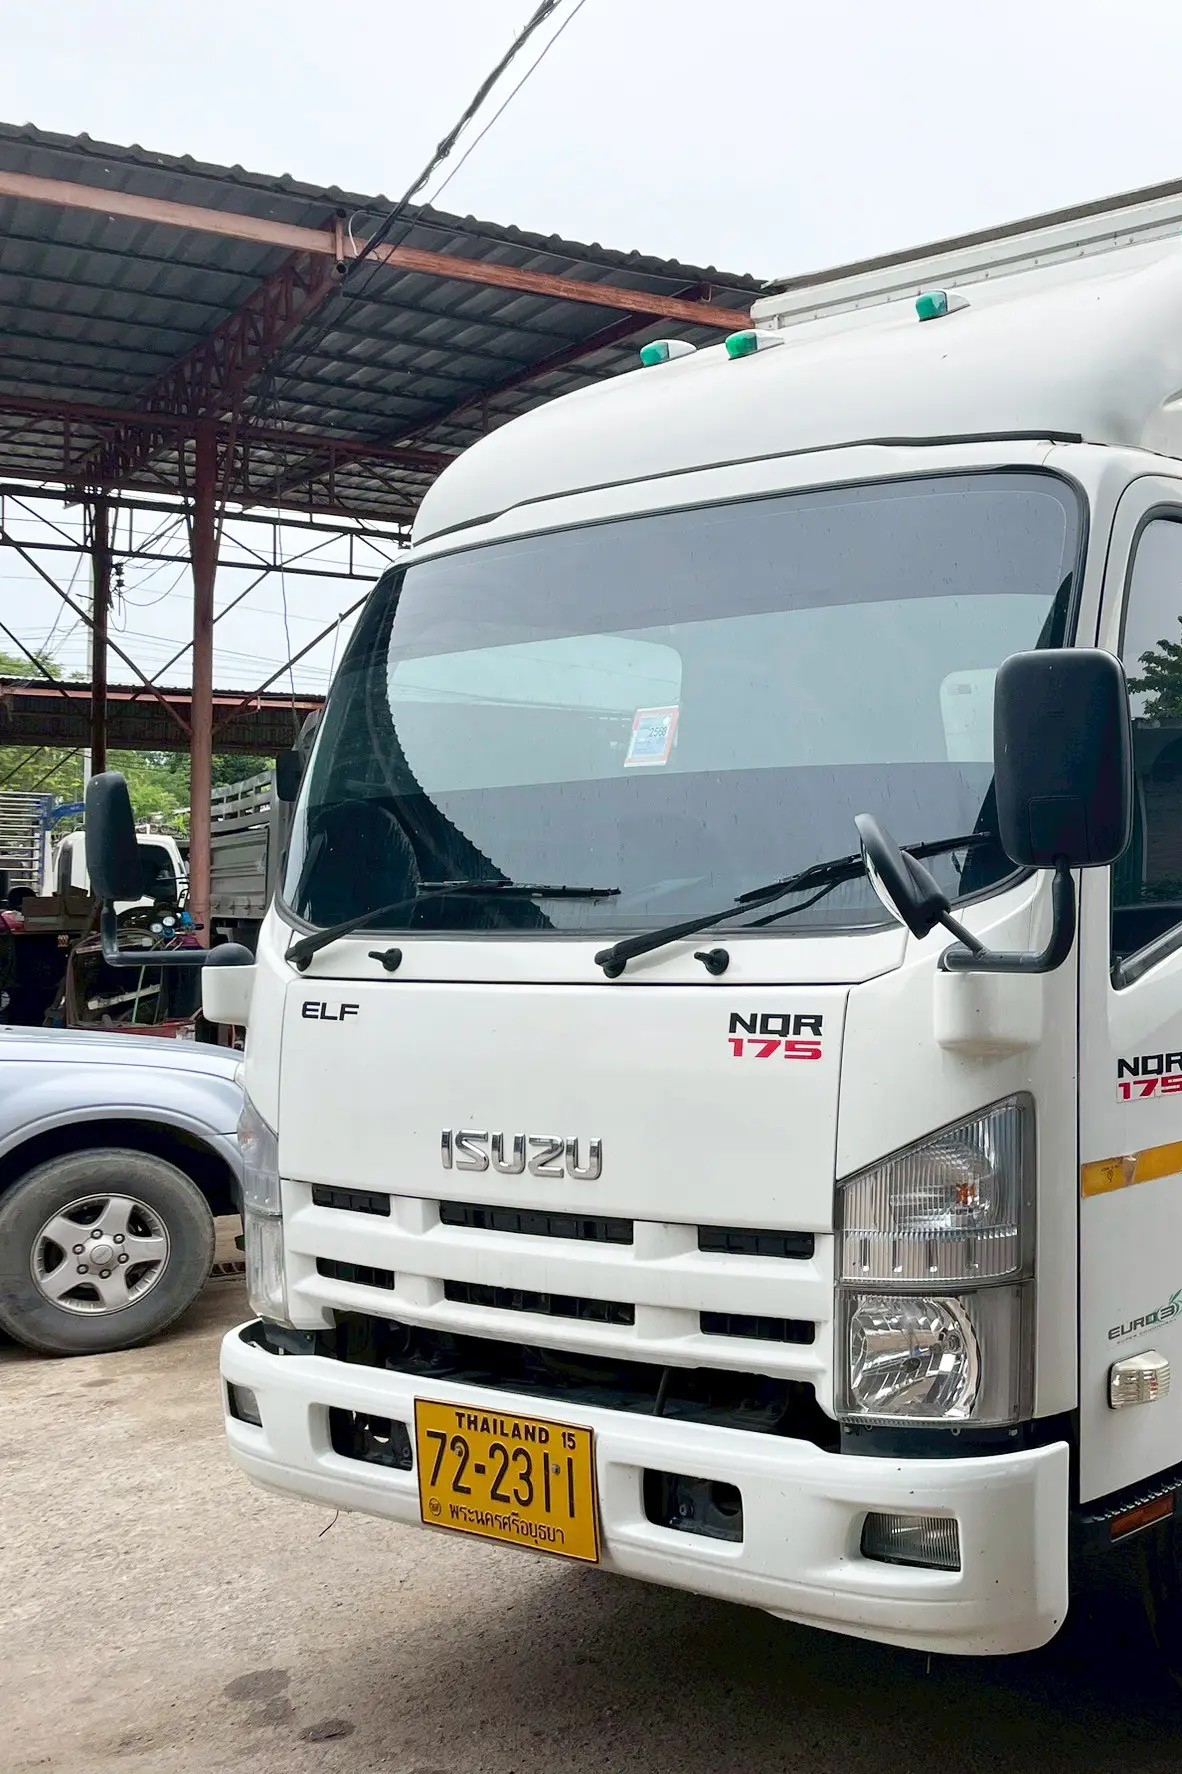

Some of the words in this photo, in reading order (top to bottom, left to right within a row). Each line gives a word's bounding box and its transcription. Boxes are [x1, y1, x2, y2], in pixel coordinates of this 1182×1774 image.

[302, 1001, 360, 1021] ELF
[728, 1012, 823, 1038] NQR
[728, 1038, 822, 1060] 175
[441, 1128, 602, 1180] ISUZU
[455, 1411, 550, 1444] THAILAND
[561, 1432, 576, 1450] 15
[426, 1430, 576, 1518] 72-2311
[449, 1503, 565, 1544] พระนครศรีอยุธยา
